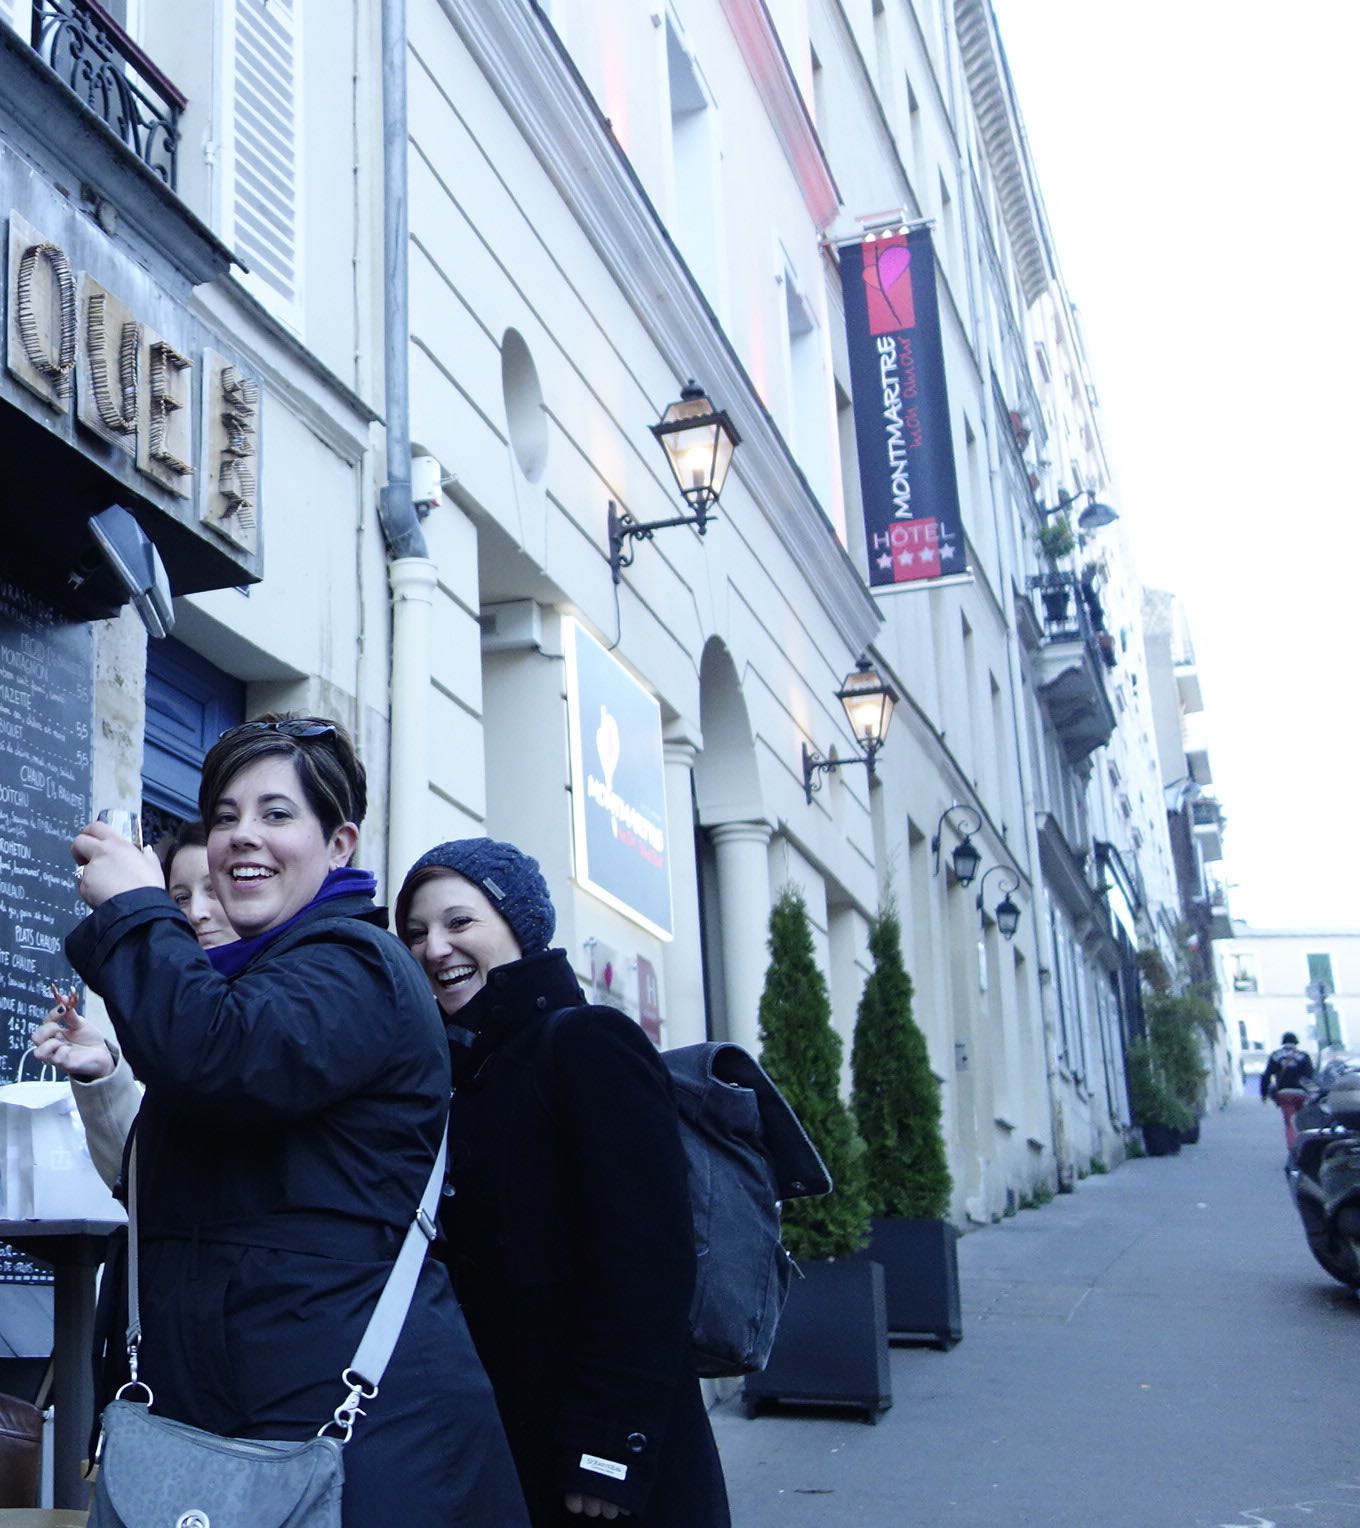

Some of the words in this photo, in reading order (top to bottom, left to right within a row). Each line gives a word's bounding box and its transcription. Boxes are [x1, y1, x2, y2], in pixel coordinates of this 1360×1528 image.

[877, 336, 913, 518] MONTMARTRE
[874, 521, 956, 550] HÔTEL
[15, 925, 34, 945] PLATS
